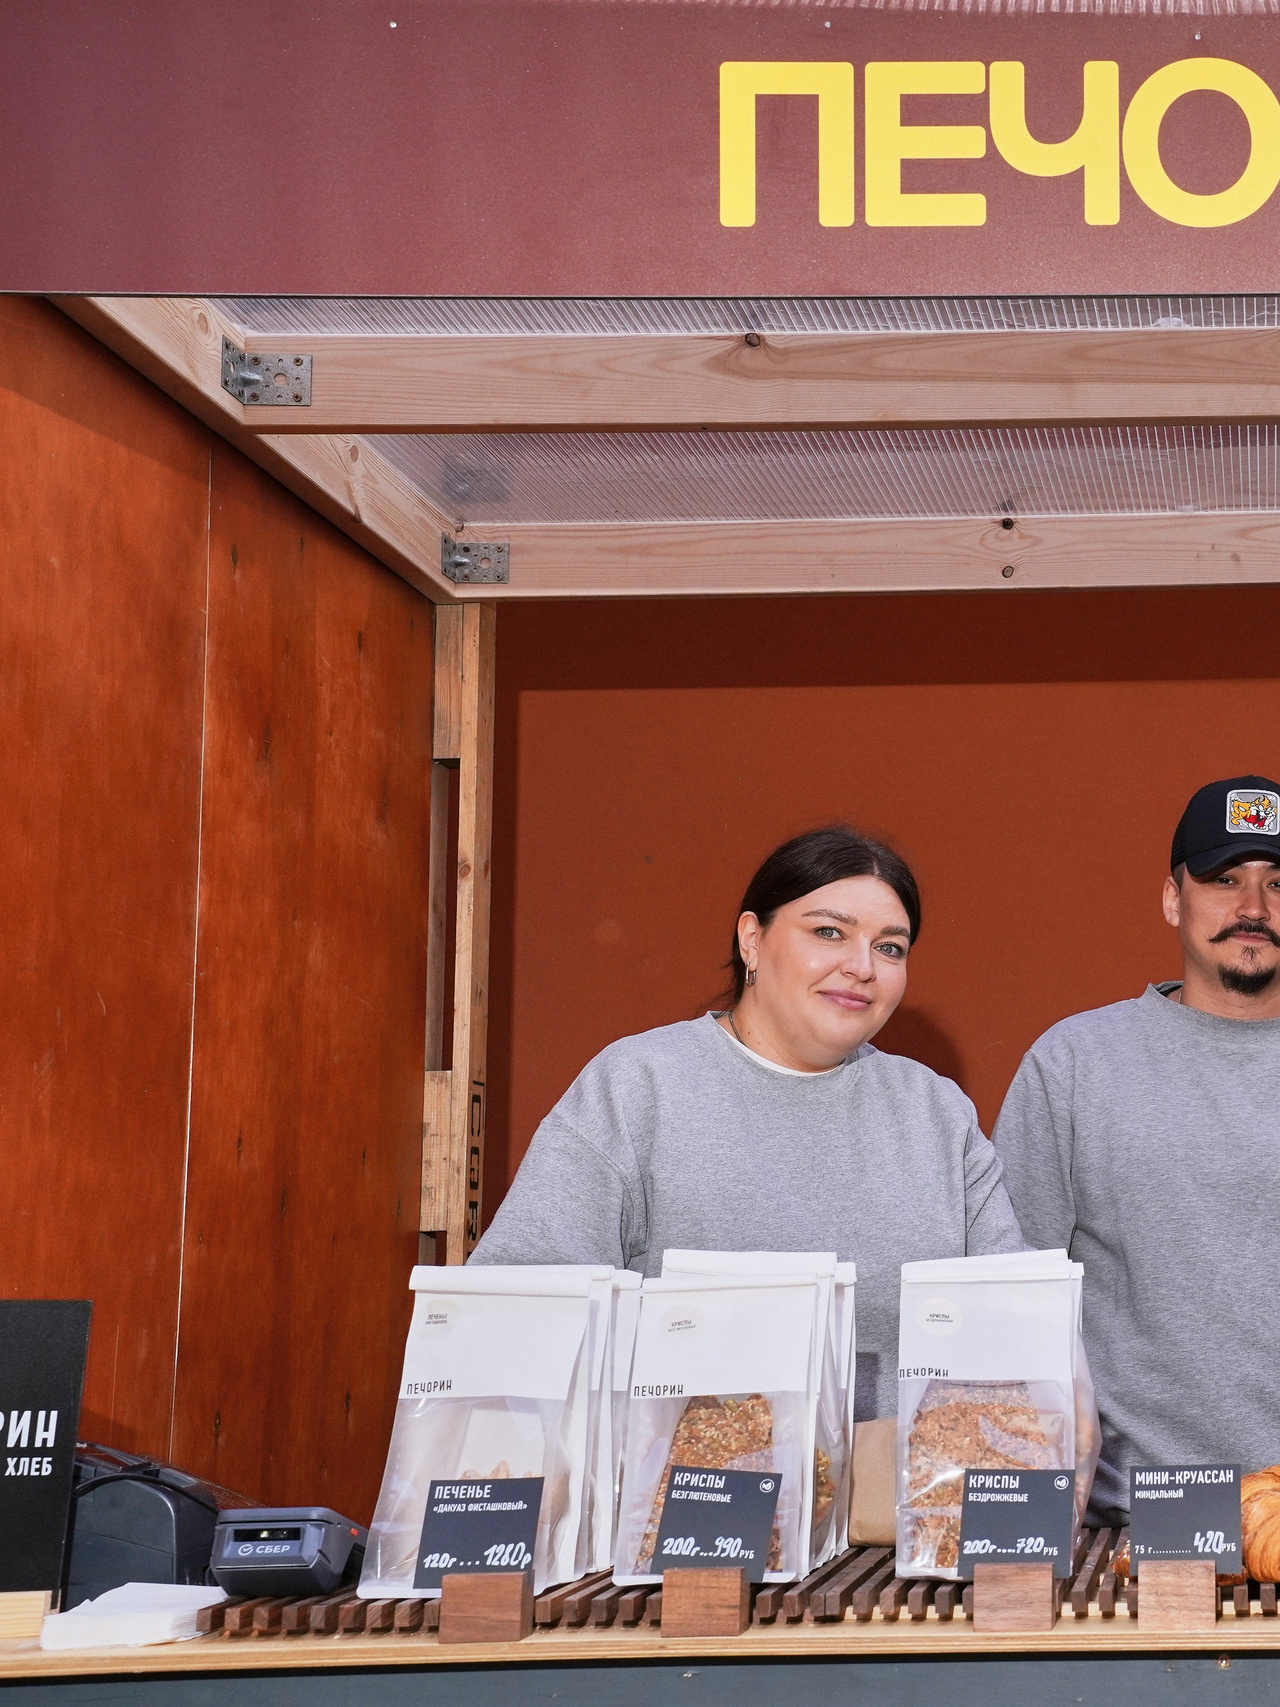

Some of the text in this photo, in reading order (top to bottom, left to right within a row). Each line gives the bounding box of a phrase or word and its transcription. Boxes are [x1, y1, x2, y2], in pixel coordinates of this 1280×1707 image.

[899, 1367, 949, 1379] ПЕЧОРИН
[406, 1379, 453, 1395] ПЕЧОРИН
[633, 1384, 684, 1397] ПЕЧОРИН
[4, 1457, 53, 1476] ХЛЕБ
[673, 1472, 726, 1488] КРИСПЫ
[968, 1475, 1020, 1489] КРИСПЫ
[1135, 1469, 1234, 1485] МИНИ-КРУАССАН
[434, 1484, 493, 1499] ПЕЧЕНЬЕ
[671, 1490, 732, 1503] БЕЗГЛЮТЕНОВЫЕ
[968, 1492, 1029, 1503] БЕЗДРОЖЖЕВЫЕ
[1135, 1488, 1184, 1500] МИНДАЛЬНЫЙ
[433, 1500, 528, 1514] «ДАКУАЗ ФИСТАШКОВЫЙ»
[1134, 1545, 1145, 1554] 75
[1193, 1530, 1225, 1554] 420
[1222, 1543, 1237, 1552] РУБ
[255, 1544, 291, 1554] СБЕР
[739, 1549, 755, 1559] РУБ
[1043, 1547, 1058, 1556] РУБ
